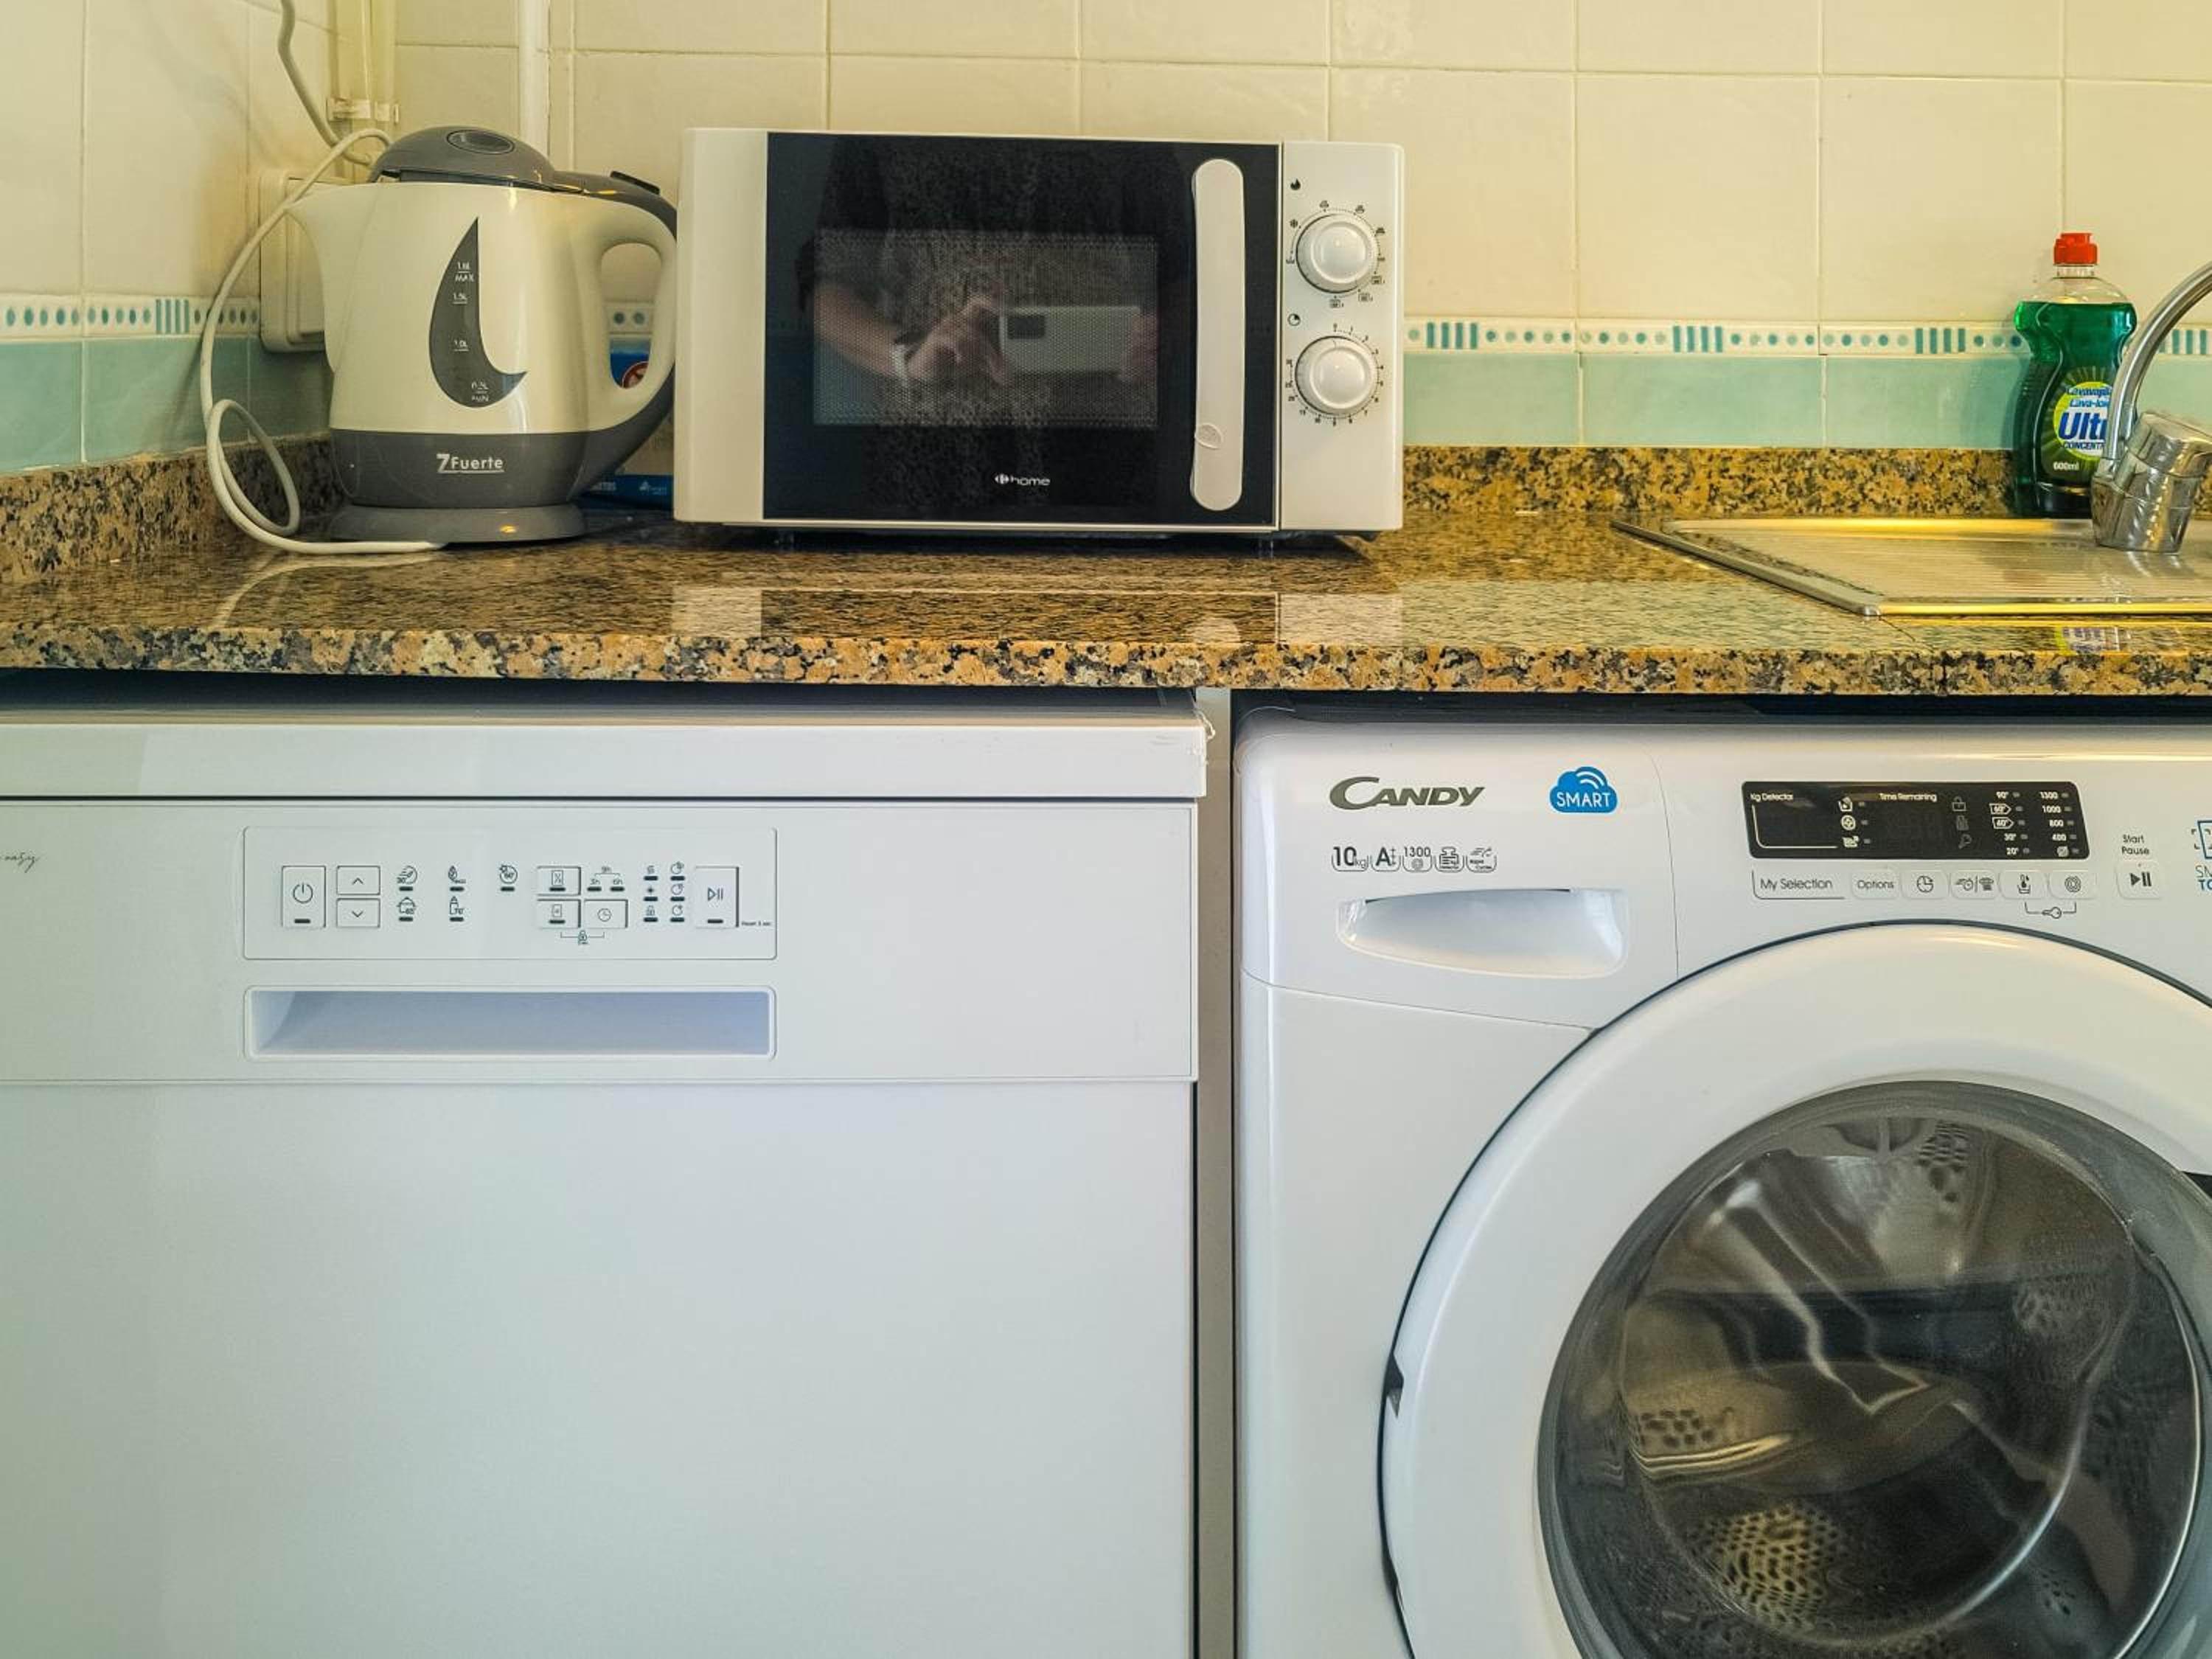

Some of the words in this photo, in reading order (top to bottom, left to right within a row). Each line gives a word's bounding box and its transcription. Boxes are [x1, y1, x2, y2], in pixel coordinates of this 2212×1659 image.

[455, 274, 474, 282] MAX
[1329, 776, 1486, 810] CANDY
[1556, 792, 1613, 809] SMART
[2123, 834, 2145, 844] Start
[1404, 846, 1431, 857] 1300
[2121, 846, 2150, 855] Pause
[1760, 878, 1778, 891] My
[1780, 878, 1833, 890] Selection
[1857, 880, 1894, 890] Options
